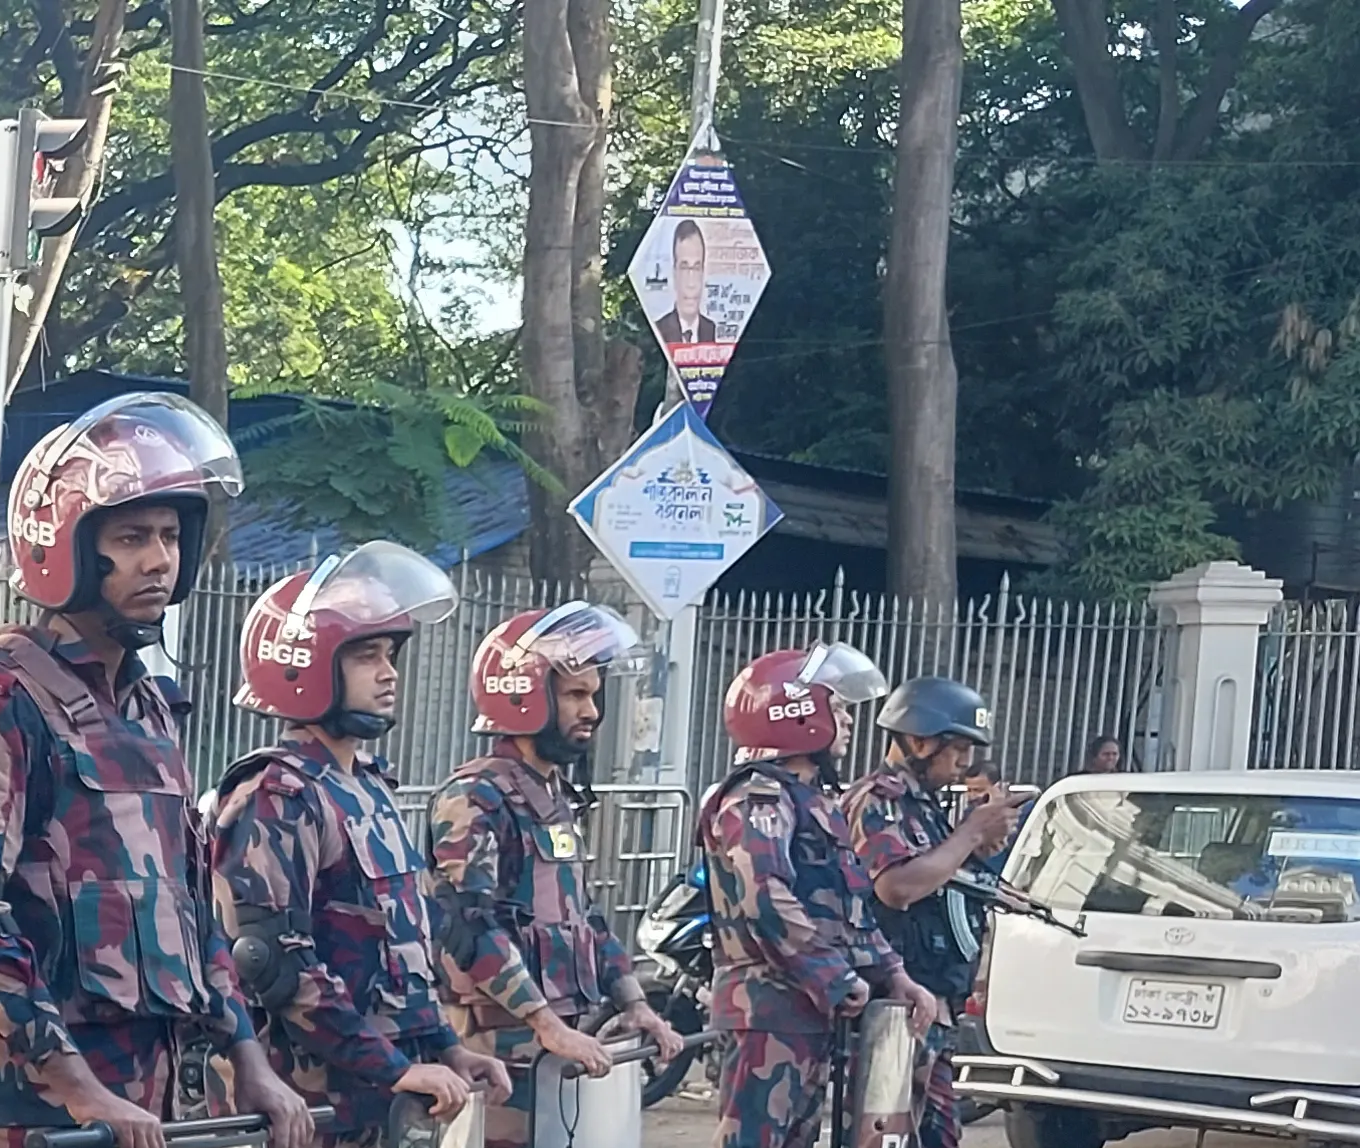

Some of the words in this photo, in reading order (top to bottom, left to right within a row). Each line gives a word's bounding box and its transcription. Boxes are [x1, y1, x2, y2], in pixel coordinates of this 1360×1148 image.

[12, 511, 56, 548] BGB
[257, 639, 312, 669] BGB
[485, 675, 534, 695] BGB
[768, 699, 817, 721] BGB
